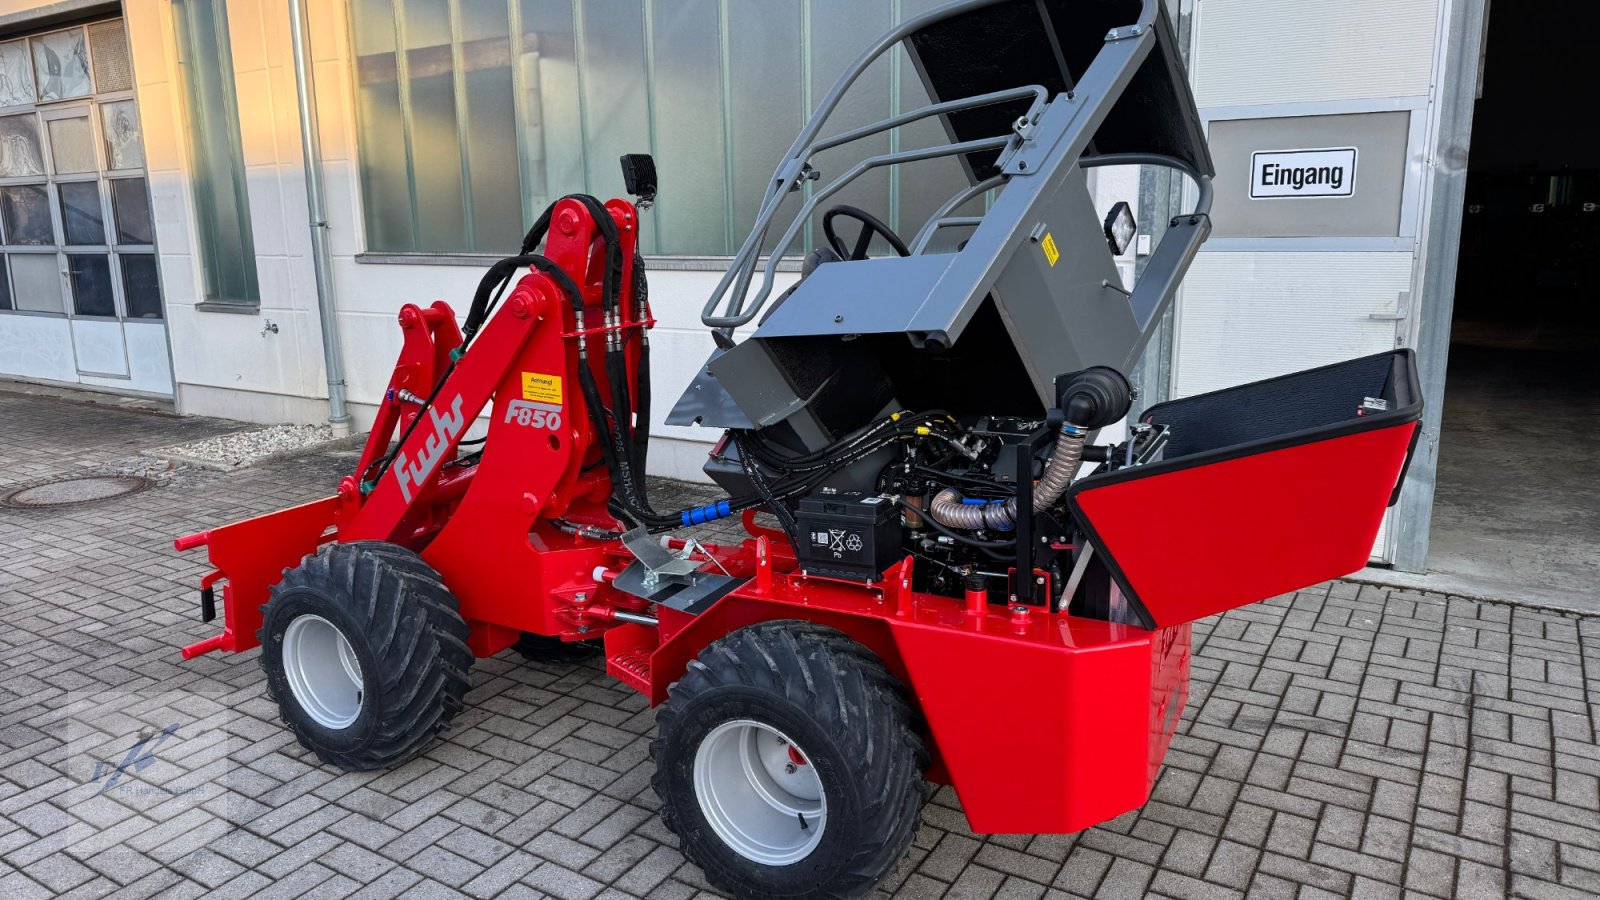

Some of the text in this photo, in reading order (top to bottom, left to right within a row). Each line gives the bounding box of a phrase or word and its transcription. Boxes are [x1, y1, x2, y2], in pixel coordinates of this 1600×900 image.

[1261, 163, 1343, 190] Eingang
[504, 399, 563, 431] F850
[393, 393, 464, 504] Fuchs
[833, 551, 842, 559] Pb
